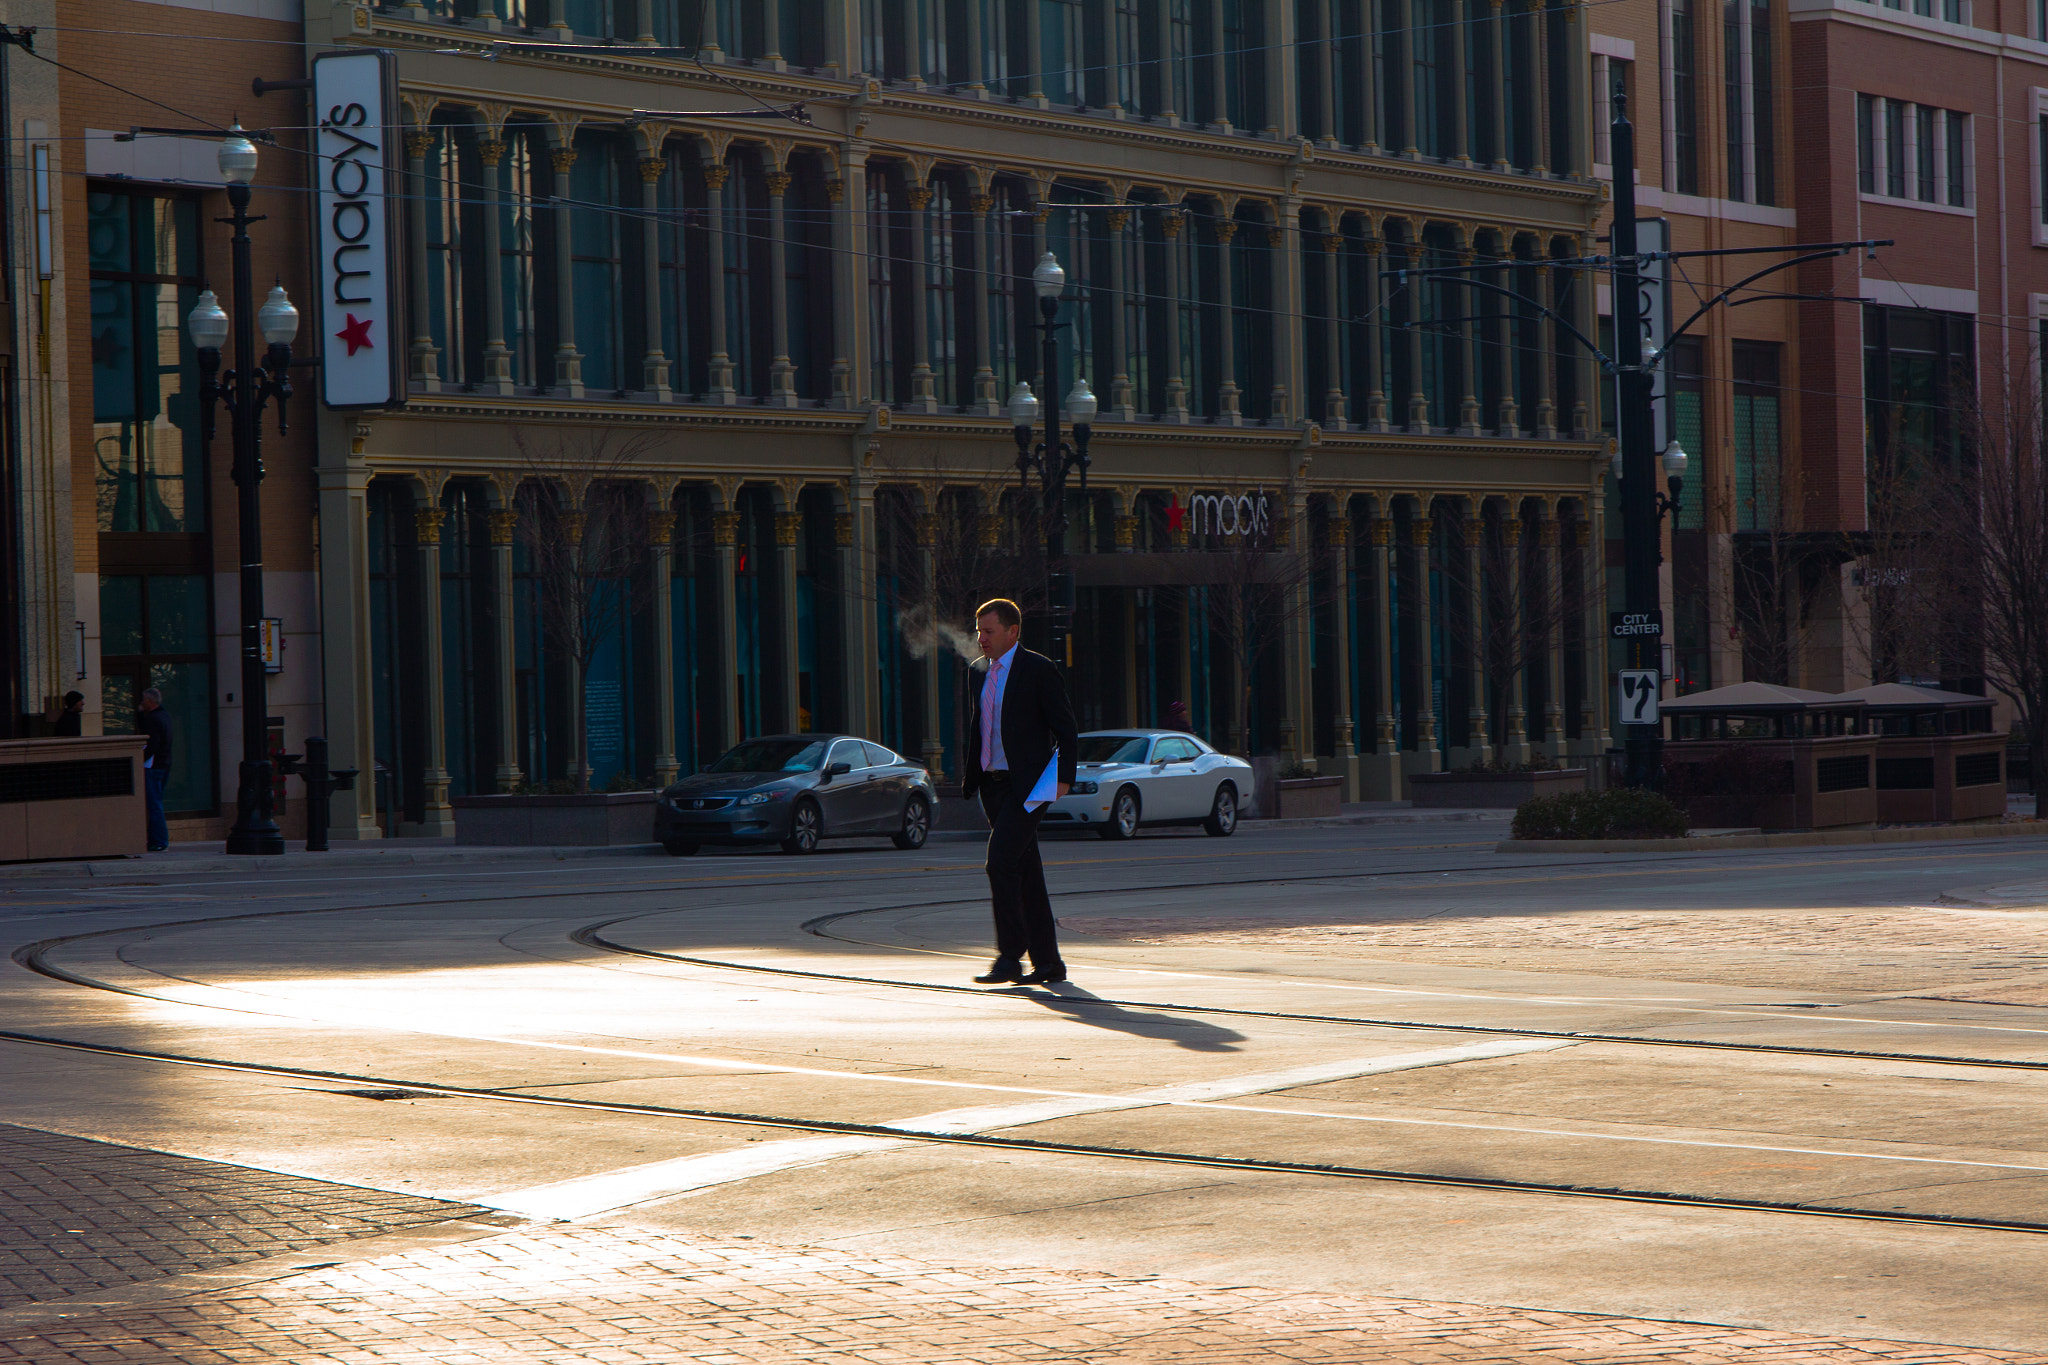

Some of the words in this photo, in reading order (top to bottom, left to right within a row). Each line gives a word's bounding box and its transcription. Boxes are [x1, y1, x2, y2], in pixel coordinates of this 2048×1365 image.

[320, 103, 379, 304] macy's
[1192, 483, 1269, 548] macy's
[1613, 623, 1660, 635] CENTER
[1622, 614, 1649, 625] CITY
